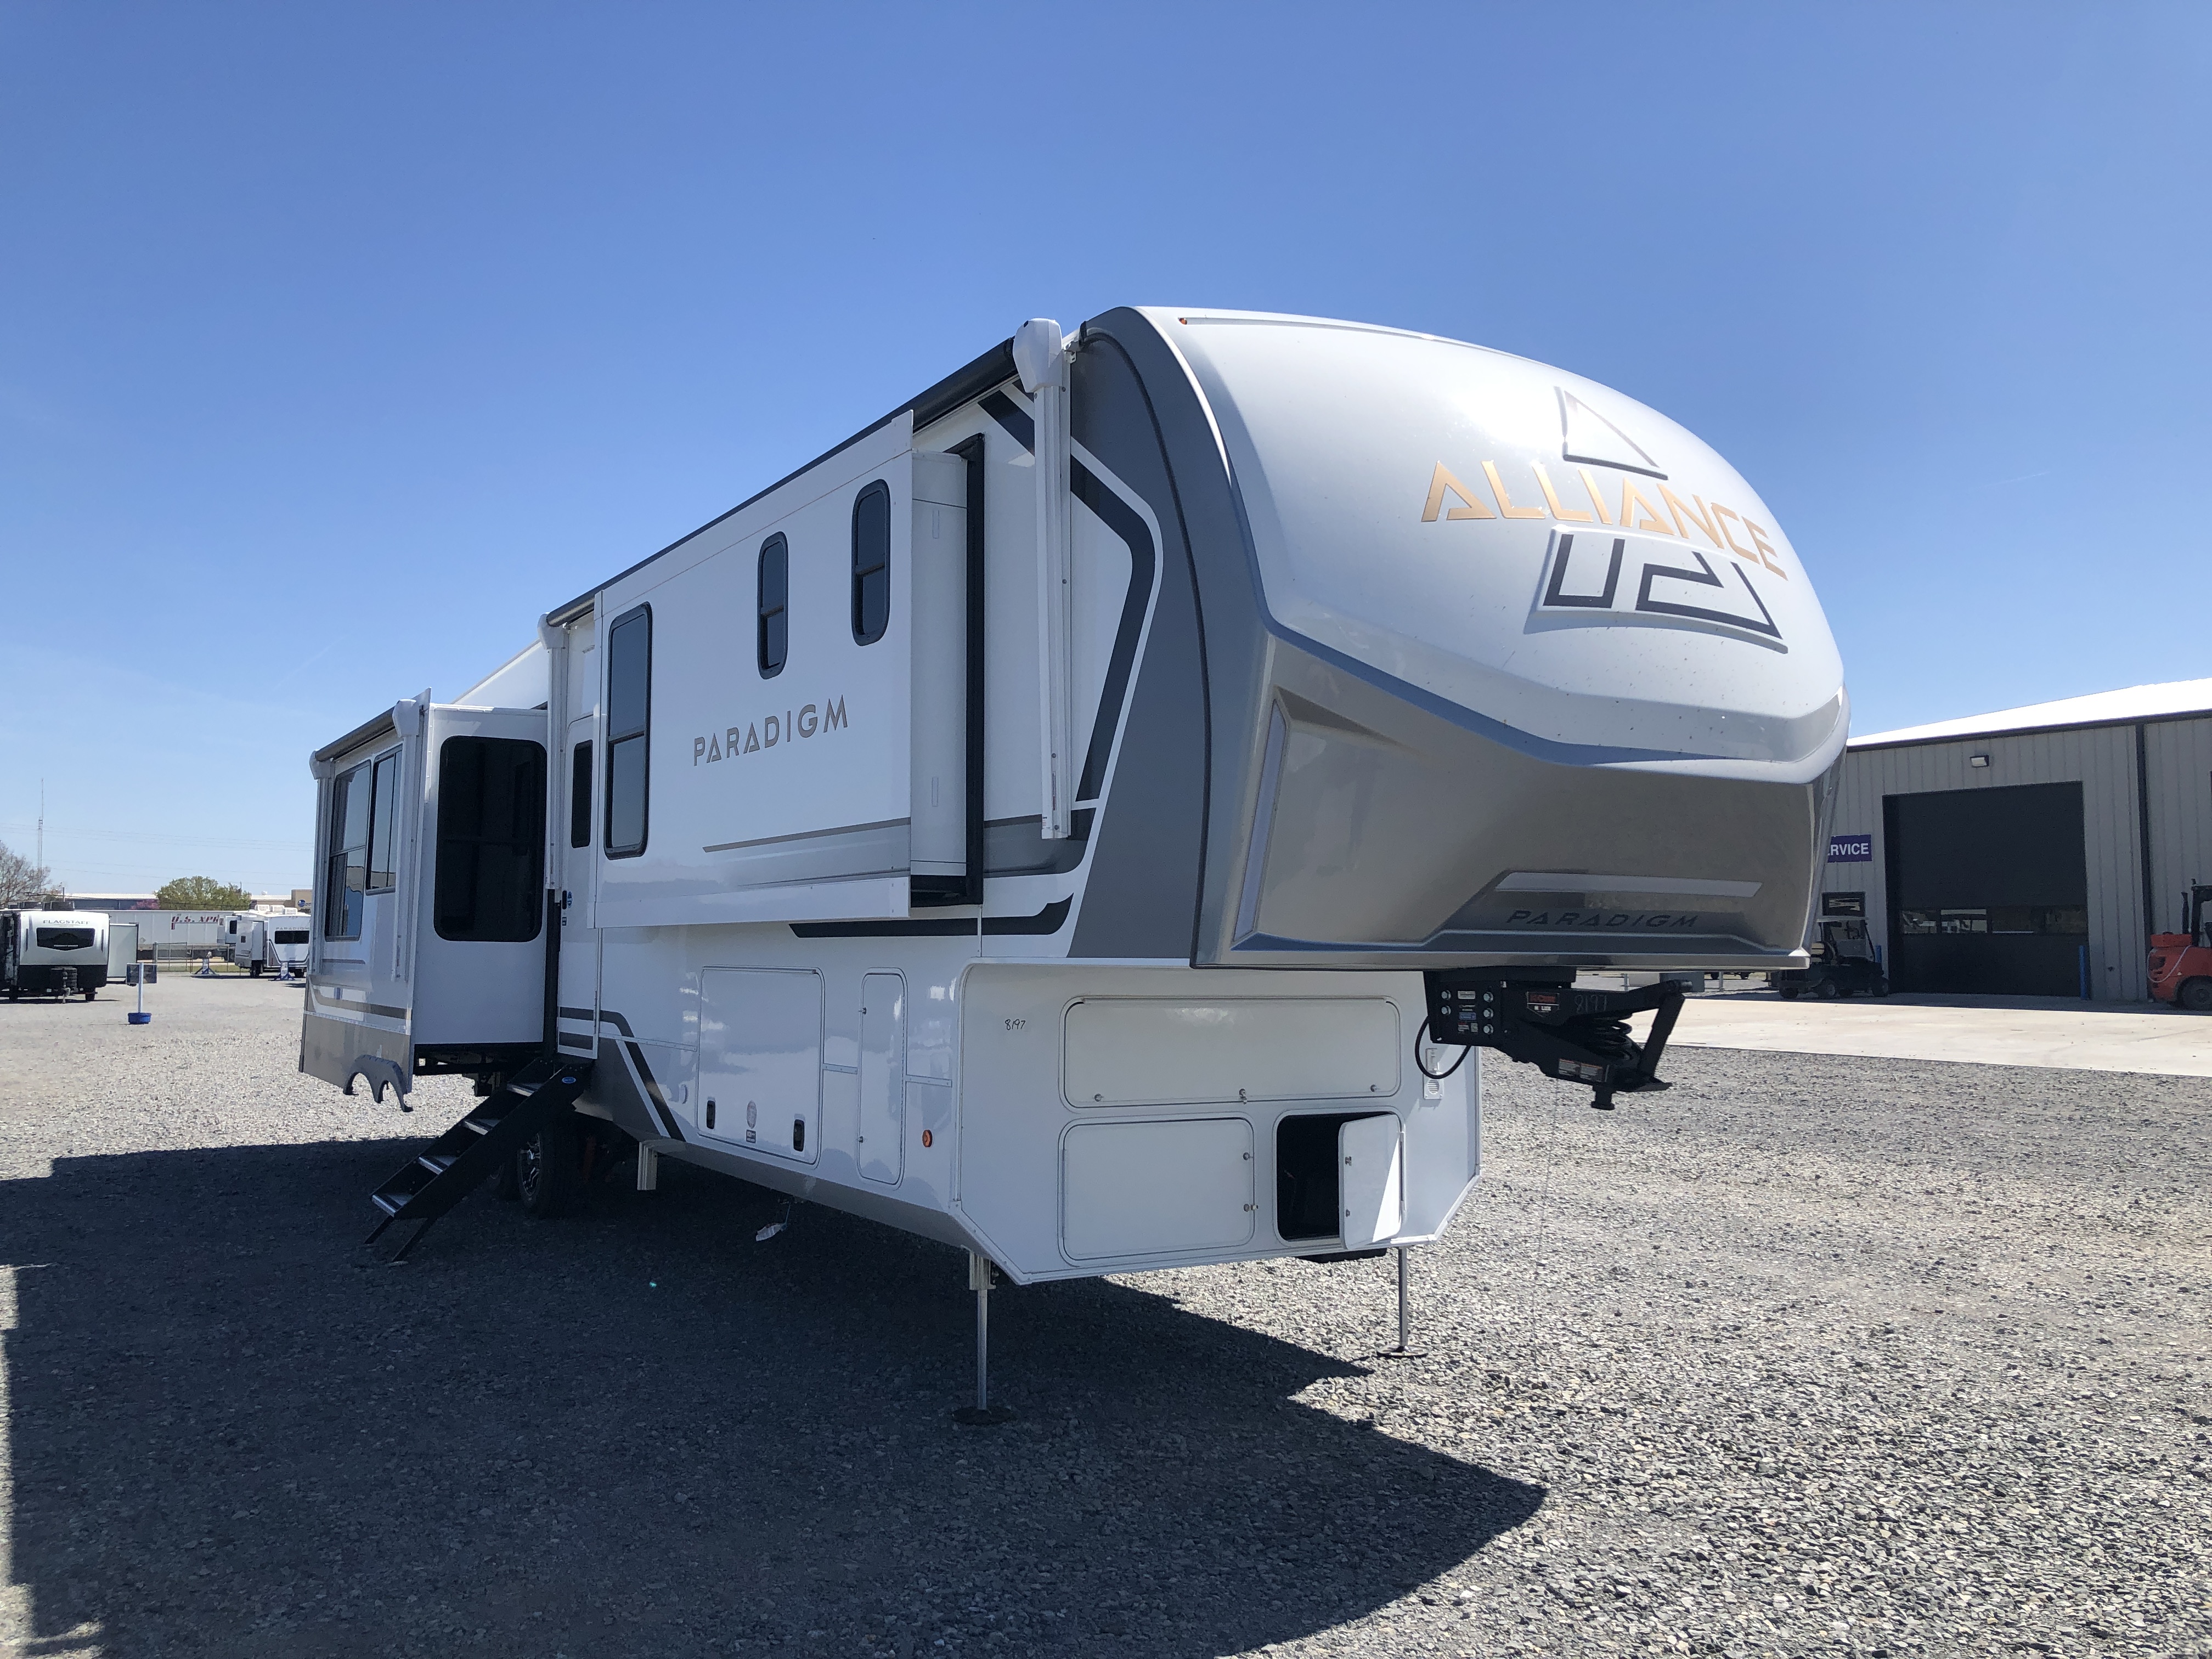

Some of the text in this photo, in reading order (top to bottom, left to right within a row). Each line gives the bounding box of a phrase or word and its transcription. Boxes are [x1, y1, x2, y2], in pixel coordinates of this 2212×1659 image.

[1421, 460, 1789, 580] ALLIANCE
[693, 694, 848, 767] PARADIGM
[1827, 843, 1869, 856] RVICE
[1506, 910, 1699, 928] PARADIGM
[1574, 994, 1607, 1014] 8197
[1005, 1018, 1026, 1031] 8197
